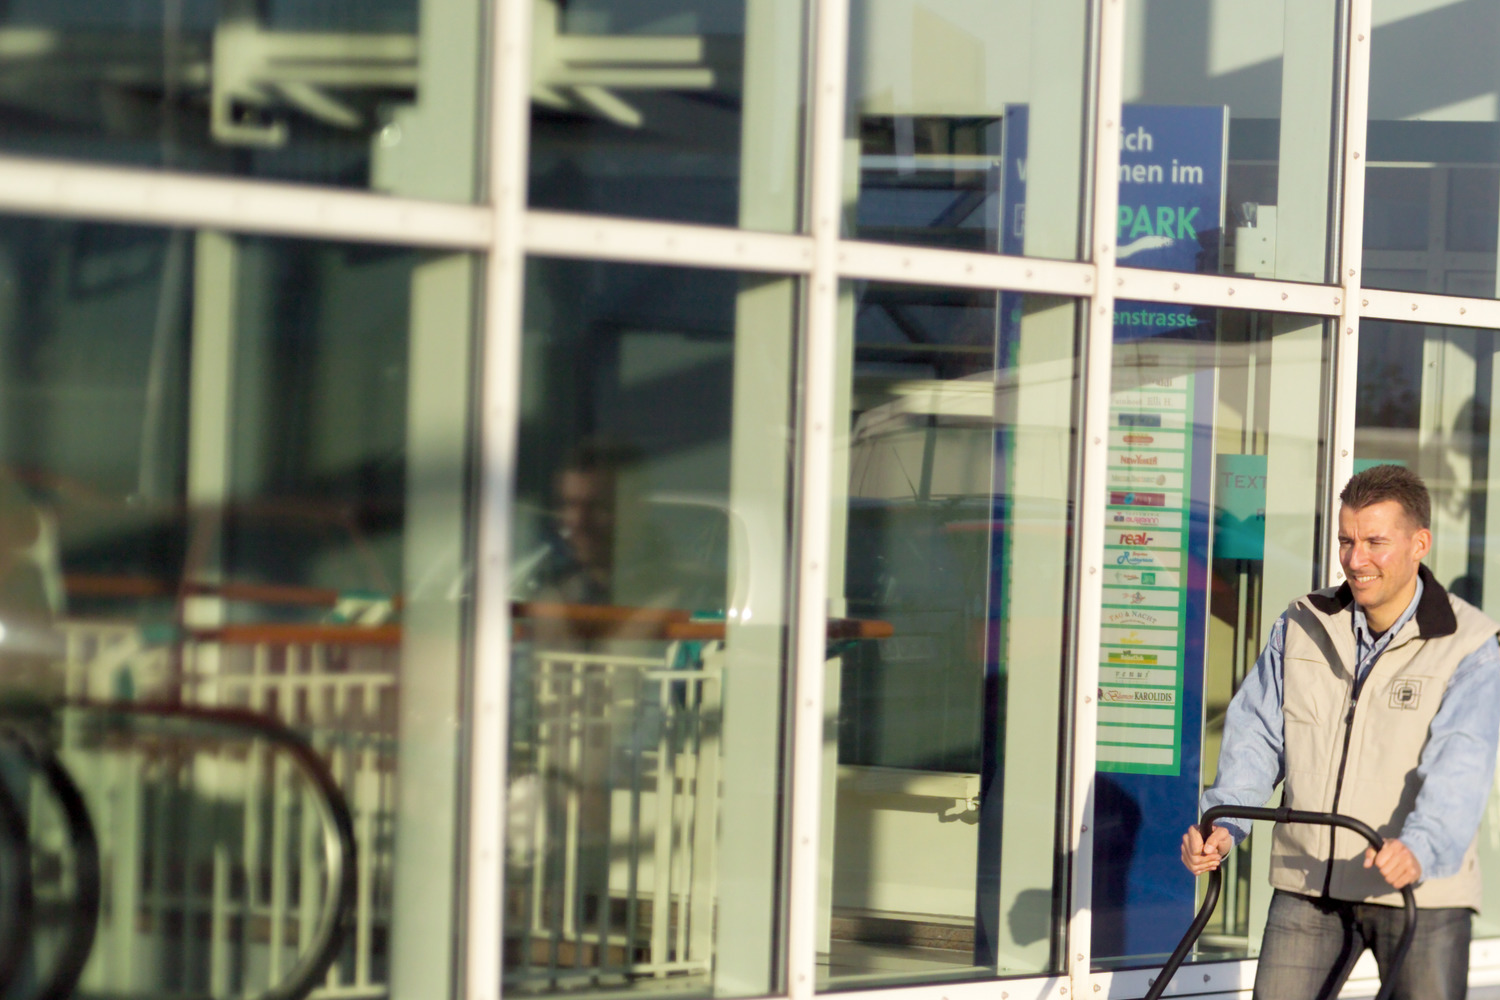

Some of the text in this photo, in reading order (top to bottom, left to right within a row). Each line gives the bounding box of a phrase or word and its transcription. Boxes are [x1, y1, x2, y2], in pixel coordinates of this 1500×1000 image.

[1172, 159, 1204, 184] im
[1117, 204, 1200, 240] PARK
[1134, 691, 1172, 702] KAROLIDIS
